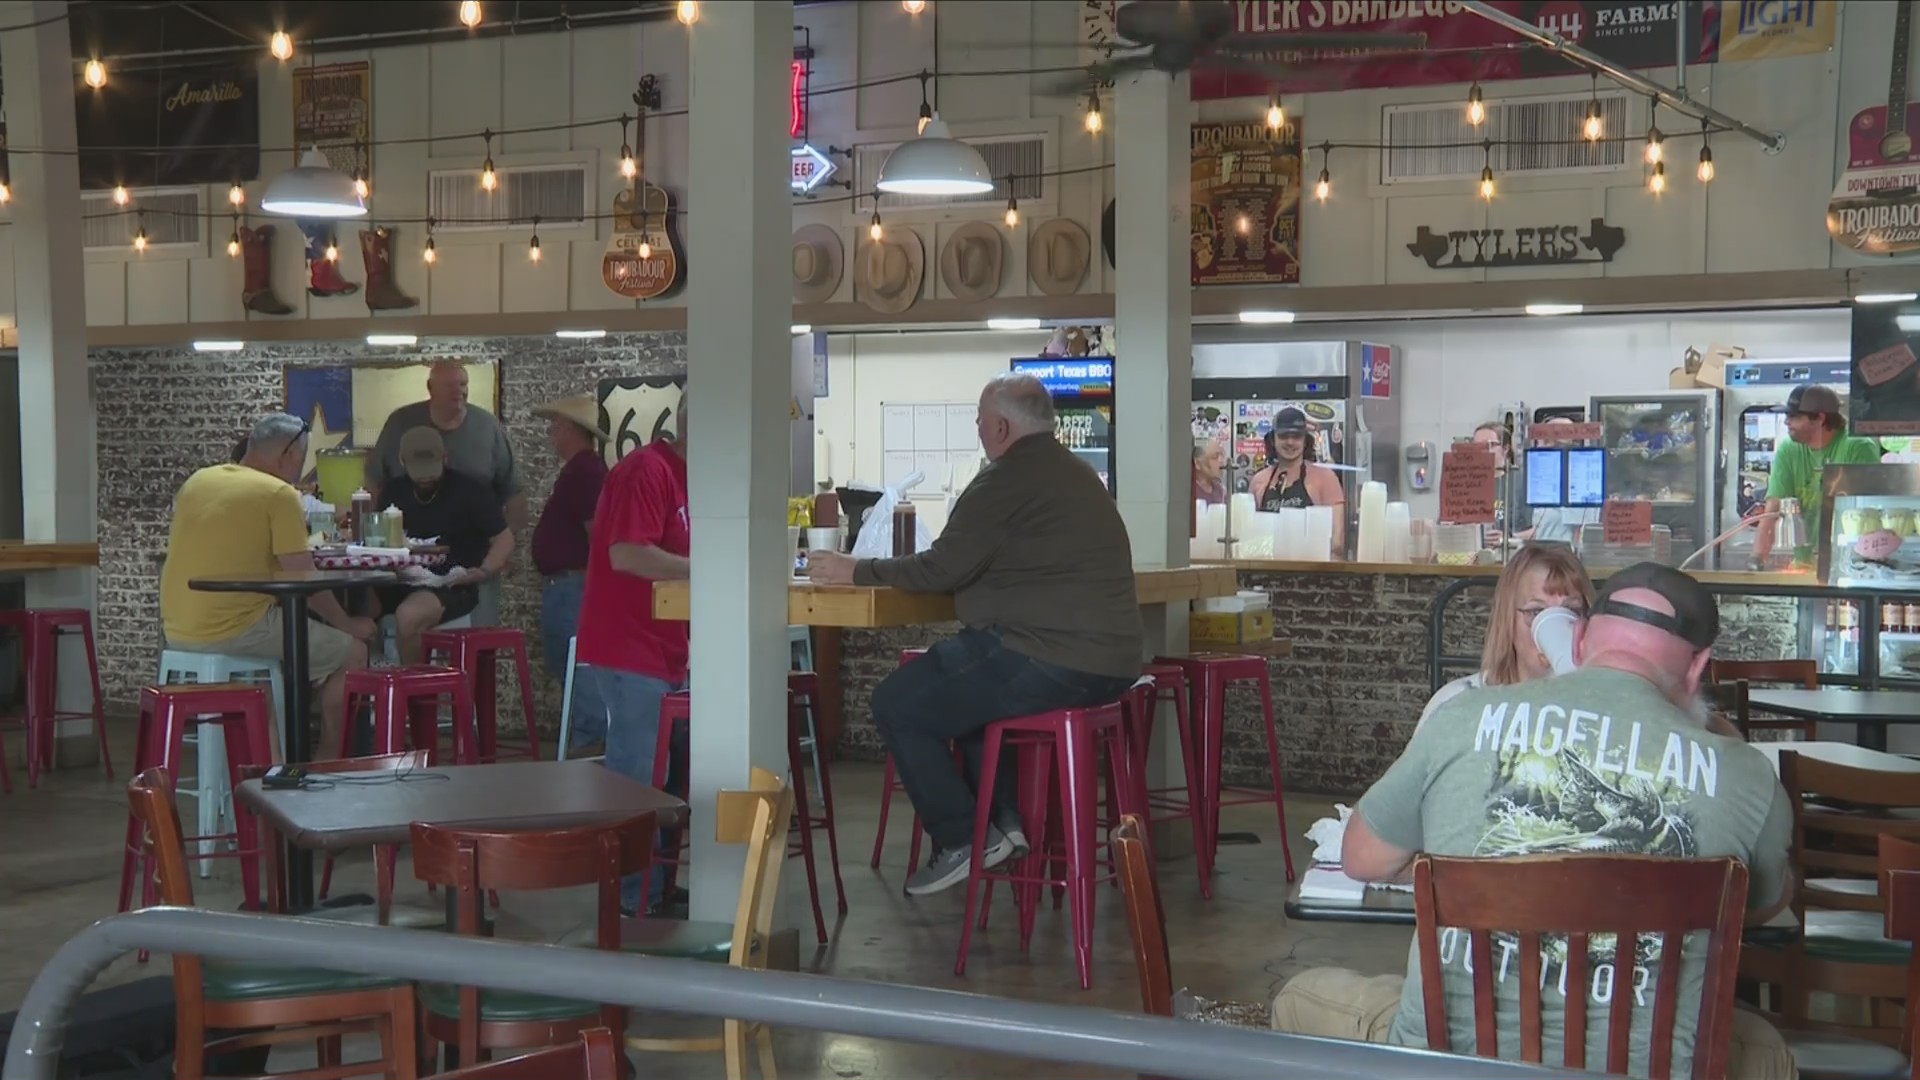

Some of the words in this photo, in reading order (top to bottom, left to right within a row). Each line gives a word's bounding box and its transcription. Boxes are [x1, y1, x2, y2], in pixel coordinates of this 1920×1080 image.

[1596, 28, 1625, 37] SINCE
[166, 81, 242, 112] Amarillo
[794, 163, 814, 176] EER
[609, 260, 666, 281] TROUBADOUR
[1057, 364, 1086, 378] Texas
[615, 405, 676, 462] 66
[1474, 702, 1717, 798] MAGELLAN
